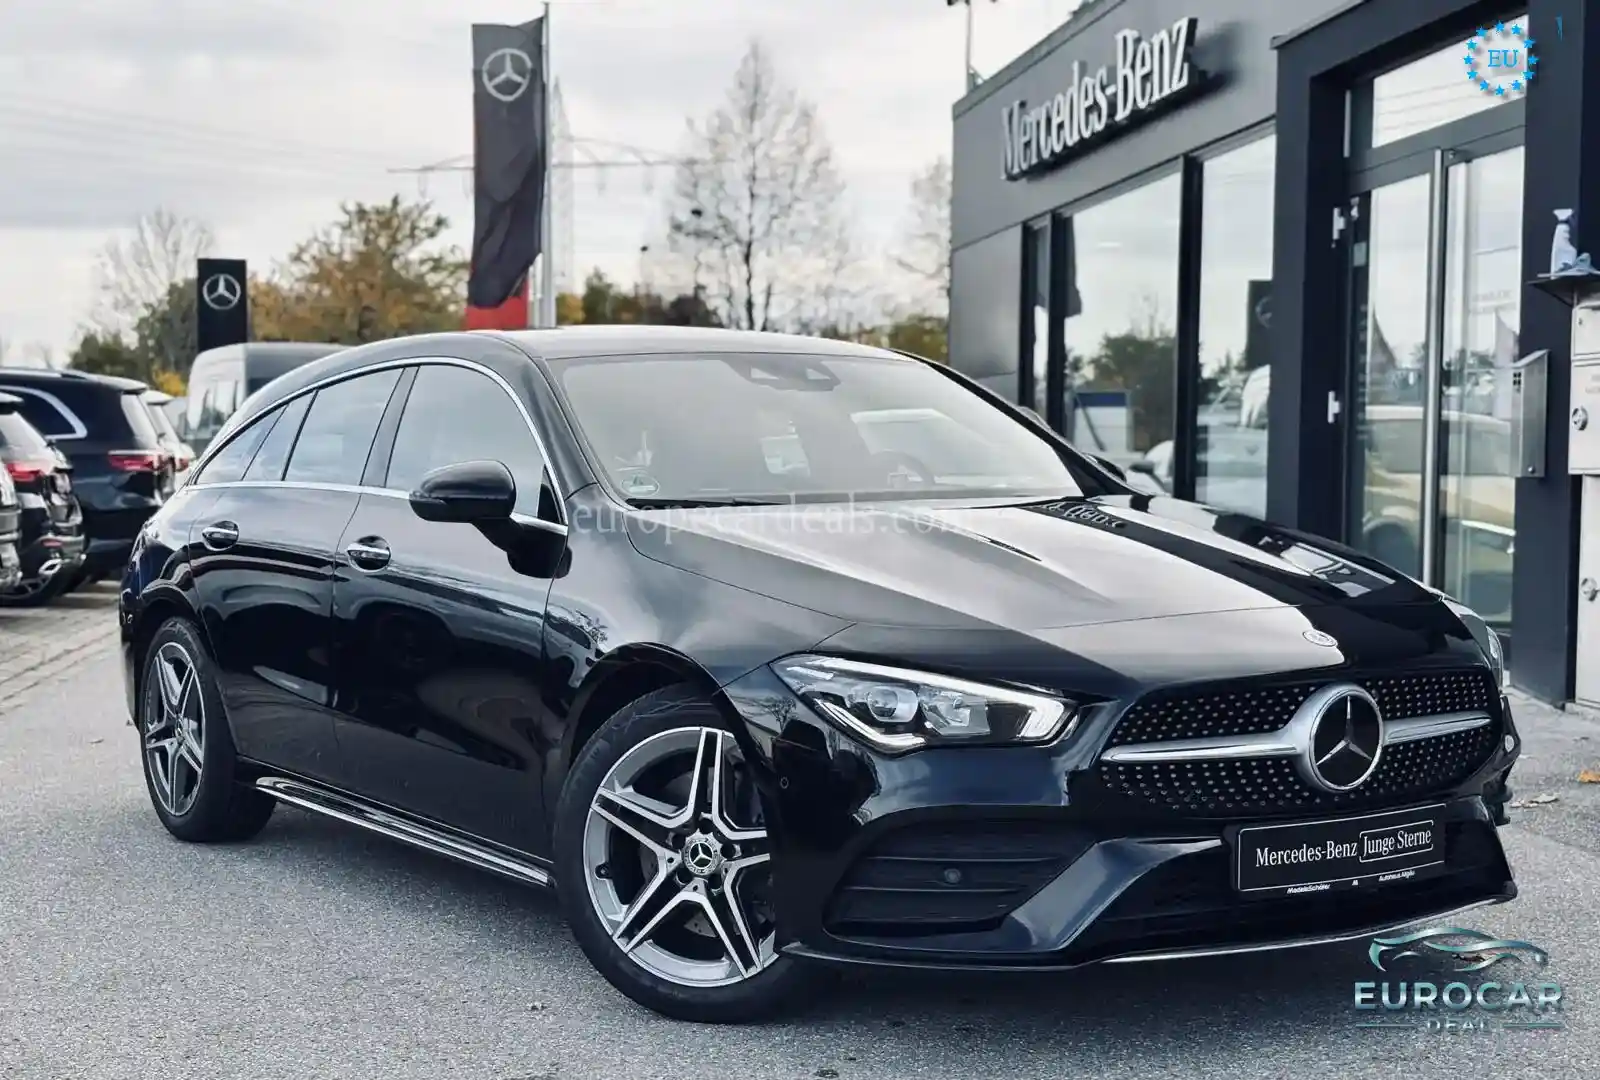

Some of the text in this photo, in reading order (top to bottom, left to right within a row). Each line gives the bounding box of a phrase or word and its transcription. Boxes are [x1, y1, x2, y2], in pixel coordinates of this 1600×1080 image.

[1001, 16, 1190, 181] Mercedes-Benz
[1255, 829, 1432, 867] Mercedes-Benz Junge Sterne
